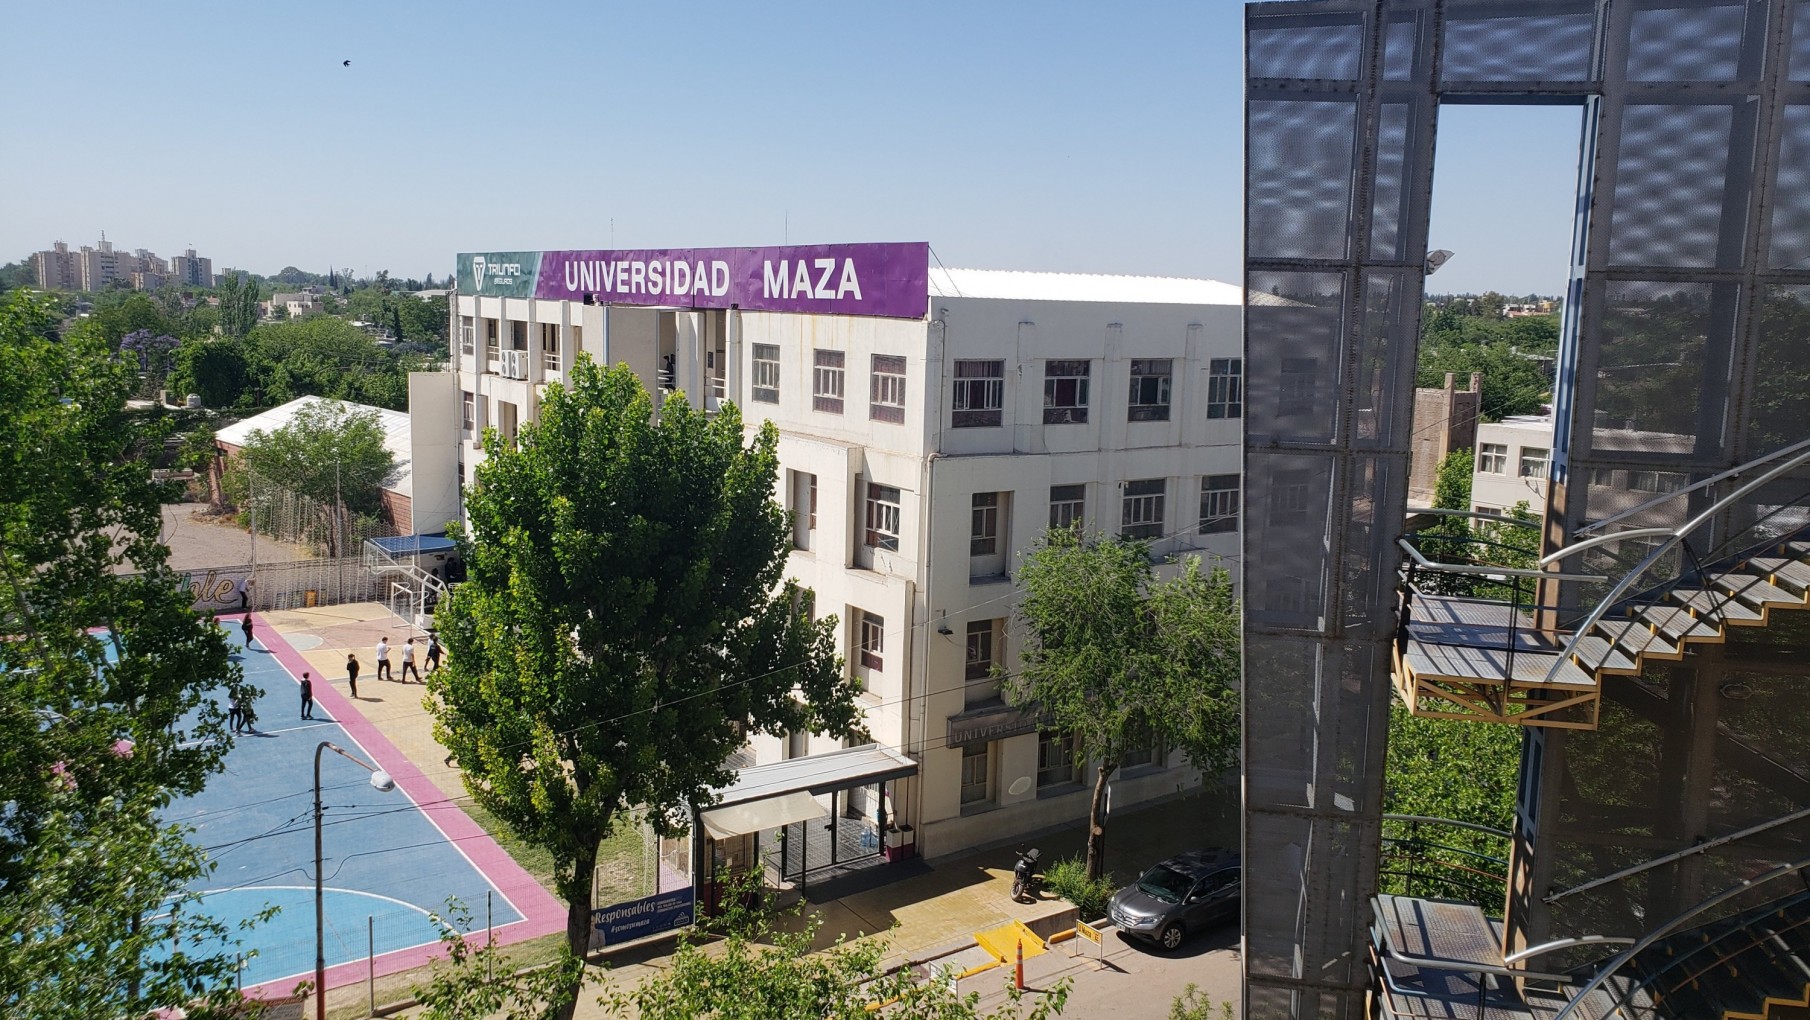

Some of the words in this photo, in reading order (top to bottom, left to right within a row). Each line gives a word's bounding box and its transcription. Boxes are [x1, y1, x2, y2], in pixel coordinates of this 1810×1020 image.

[487, 263, 521, 276] TRIUNFO
[565, 260, 731, 297] UNIVERSIDAD
[763, 258, 863, 301] MAZA
[595, 900, 656, 925] Responsables
